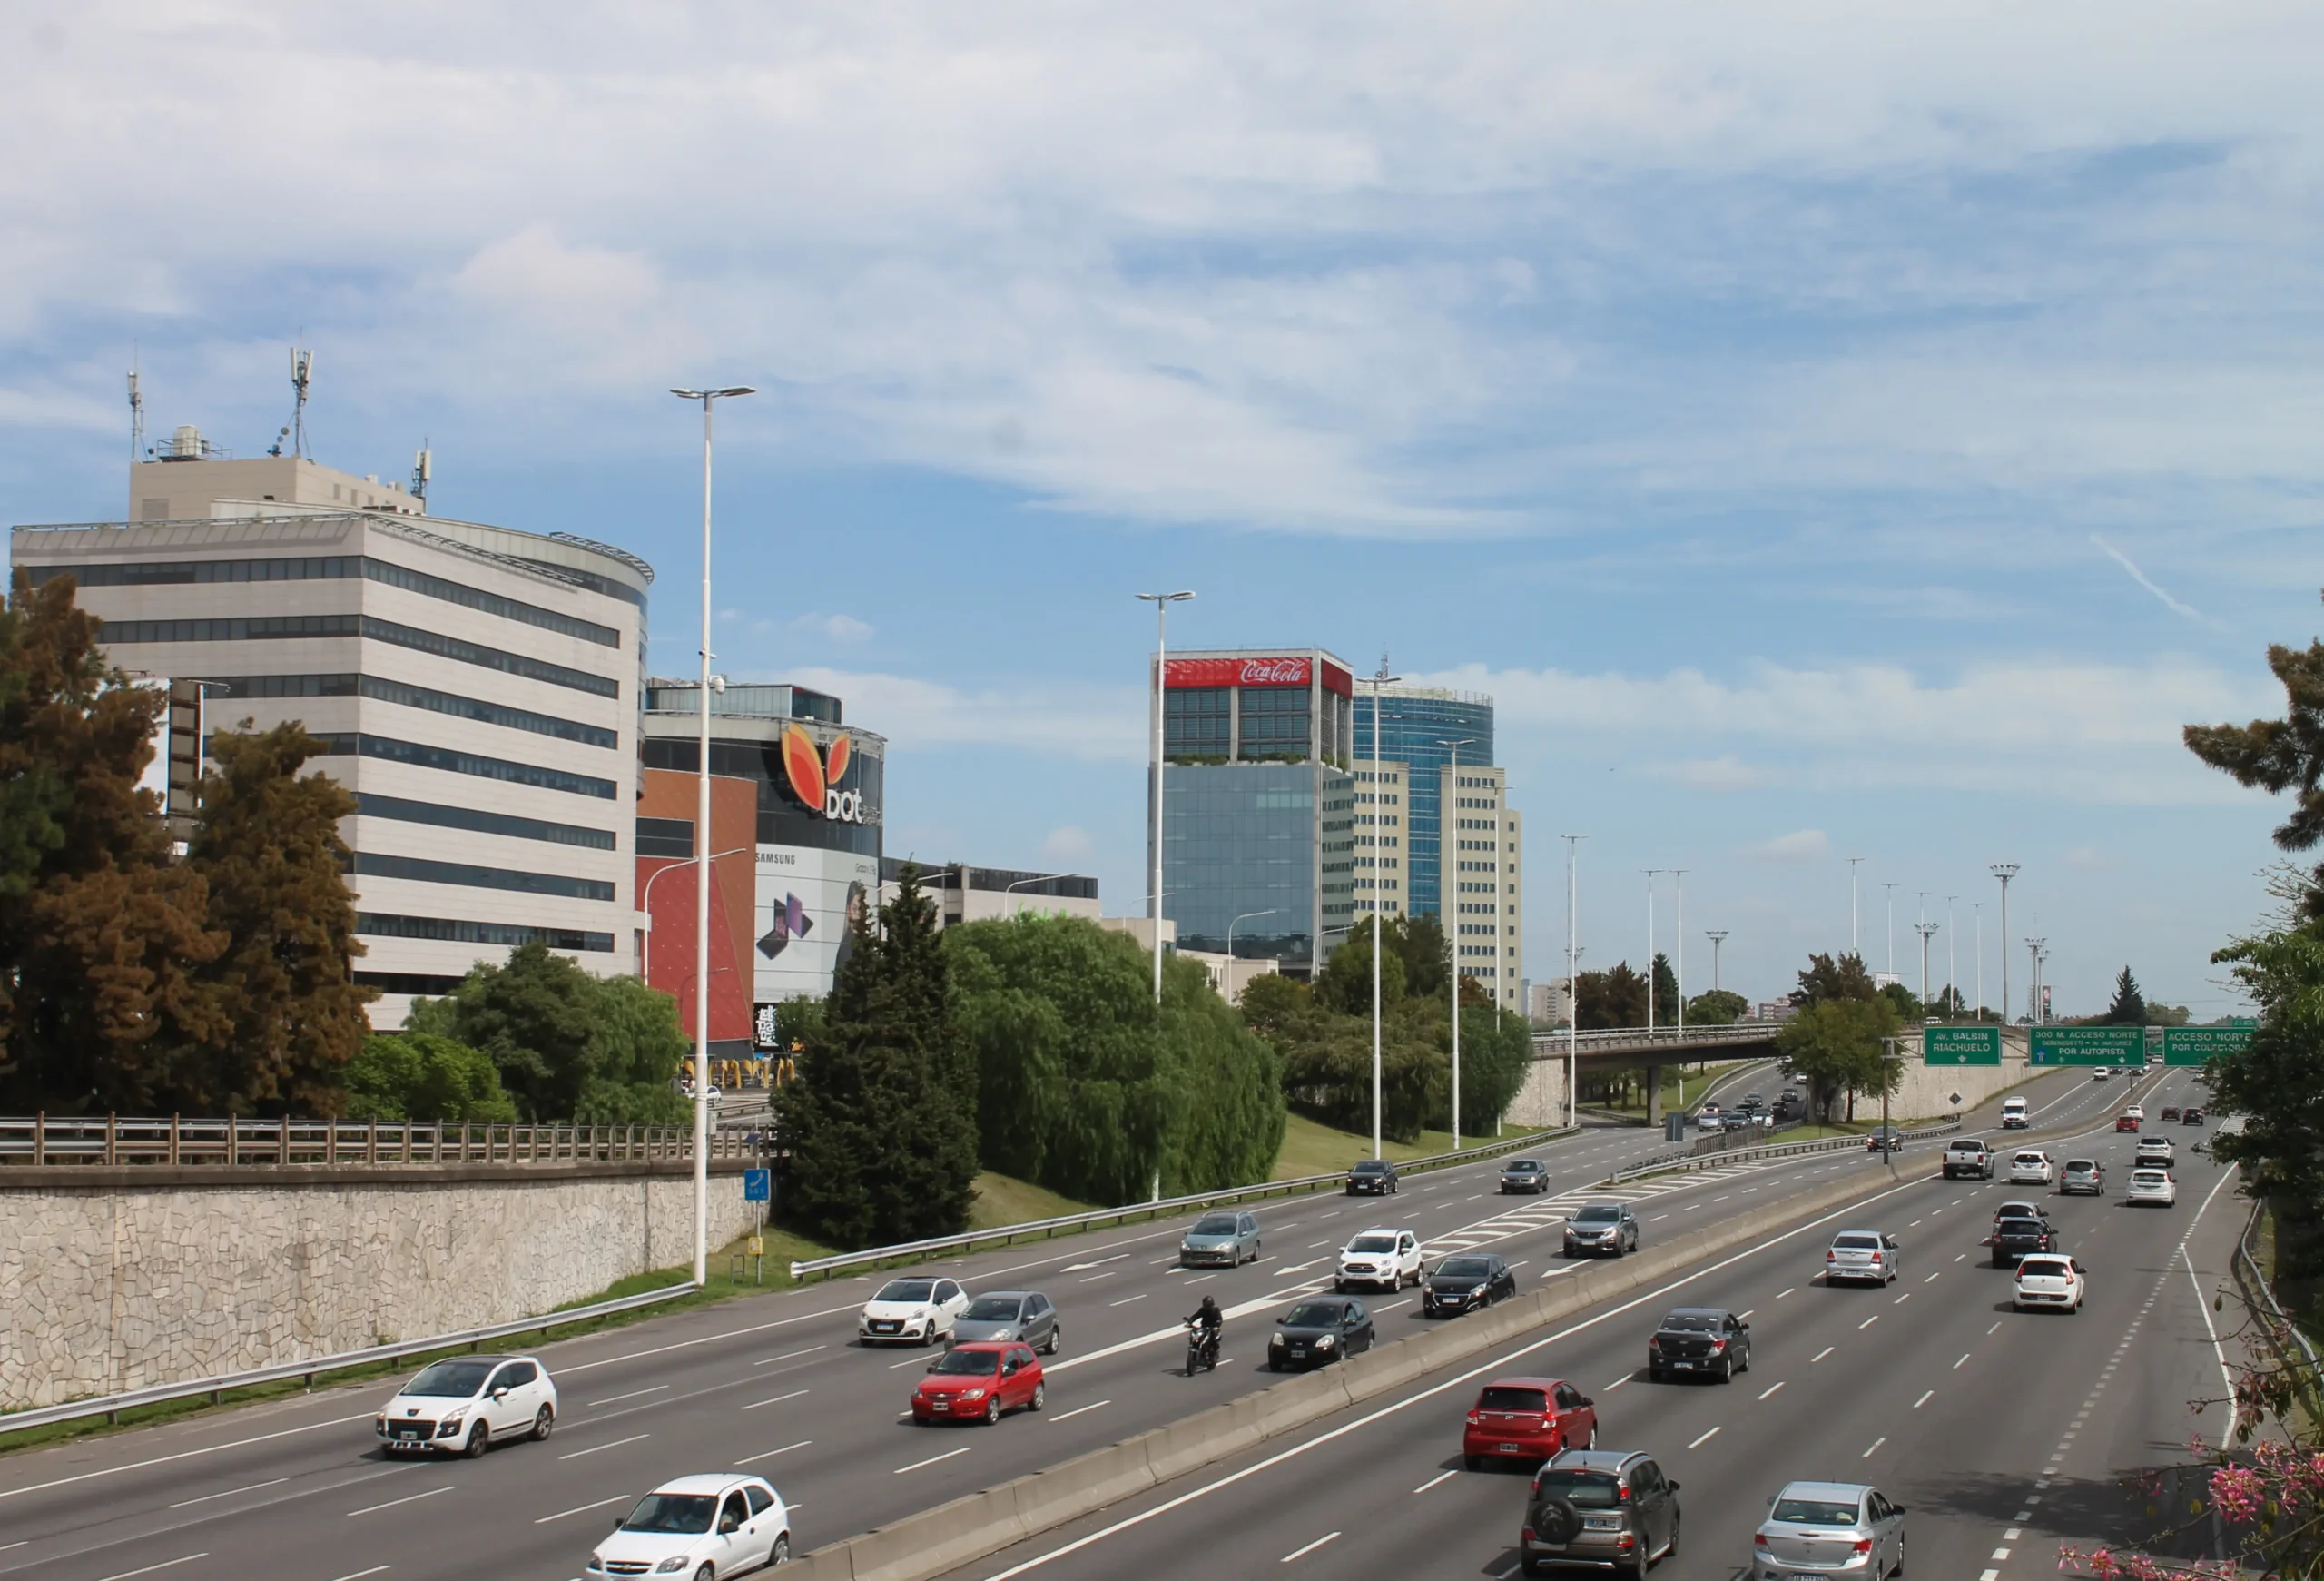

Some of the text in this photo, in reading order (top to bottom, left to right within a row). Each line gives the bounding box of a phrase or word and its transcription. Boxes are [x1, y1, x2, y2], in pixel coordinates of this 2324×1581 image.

[1240, 660, 1305, 683] Coca-Cola
[755, 852, 796, 865] SAMSUNG
[1952, 1032, 1989, 1041] BALBIN
[2168, 1033, 2212, 1042] ACCESO
[1933, 1043, 1991, 1052] RIACHUELO
[2172, 1043, 2191, 1052] POR
